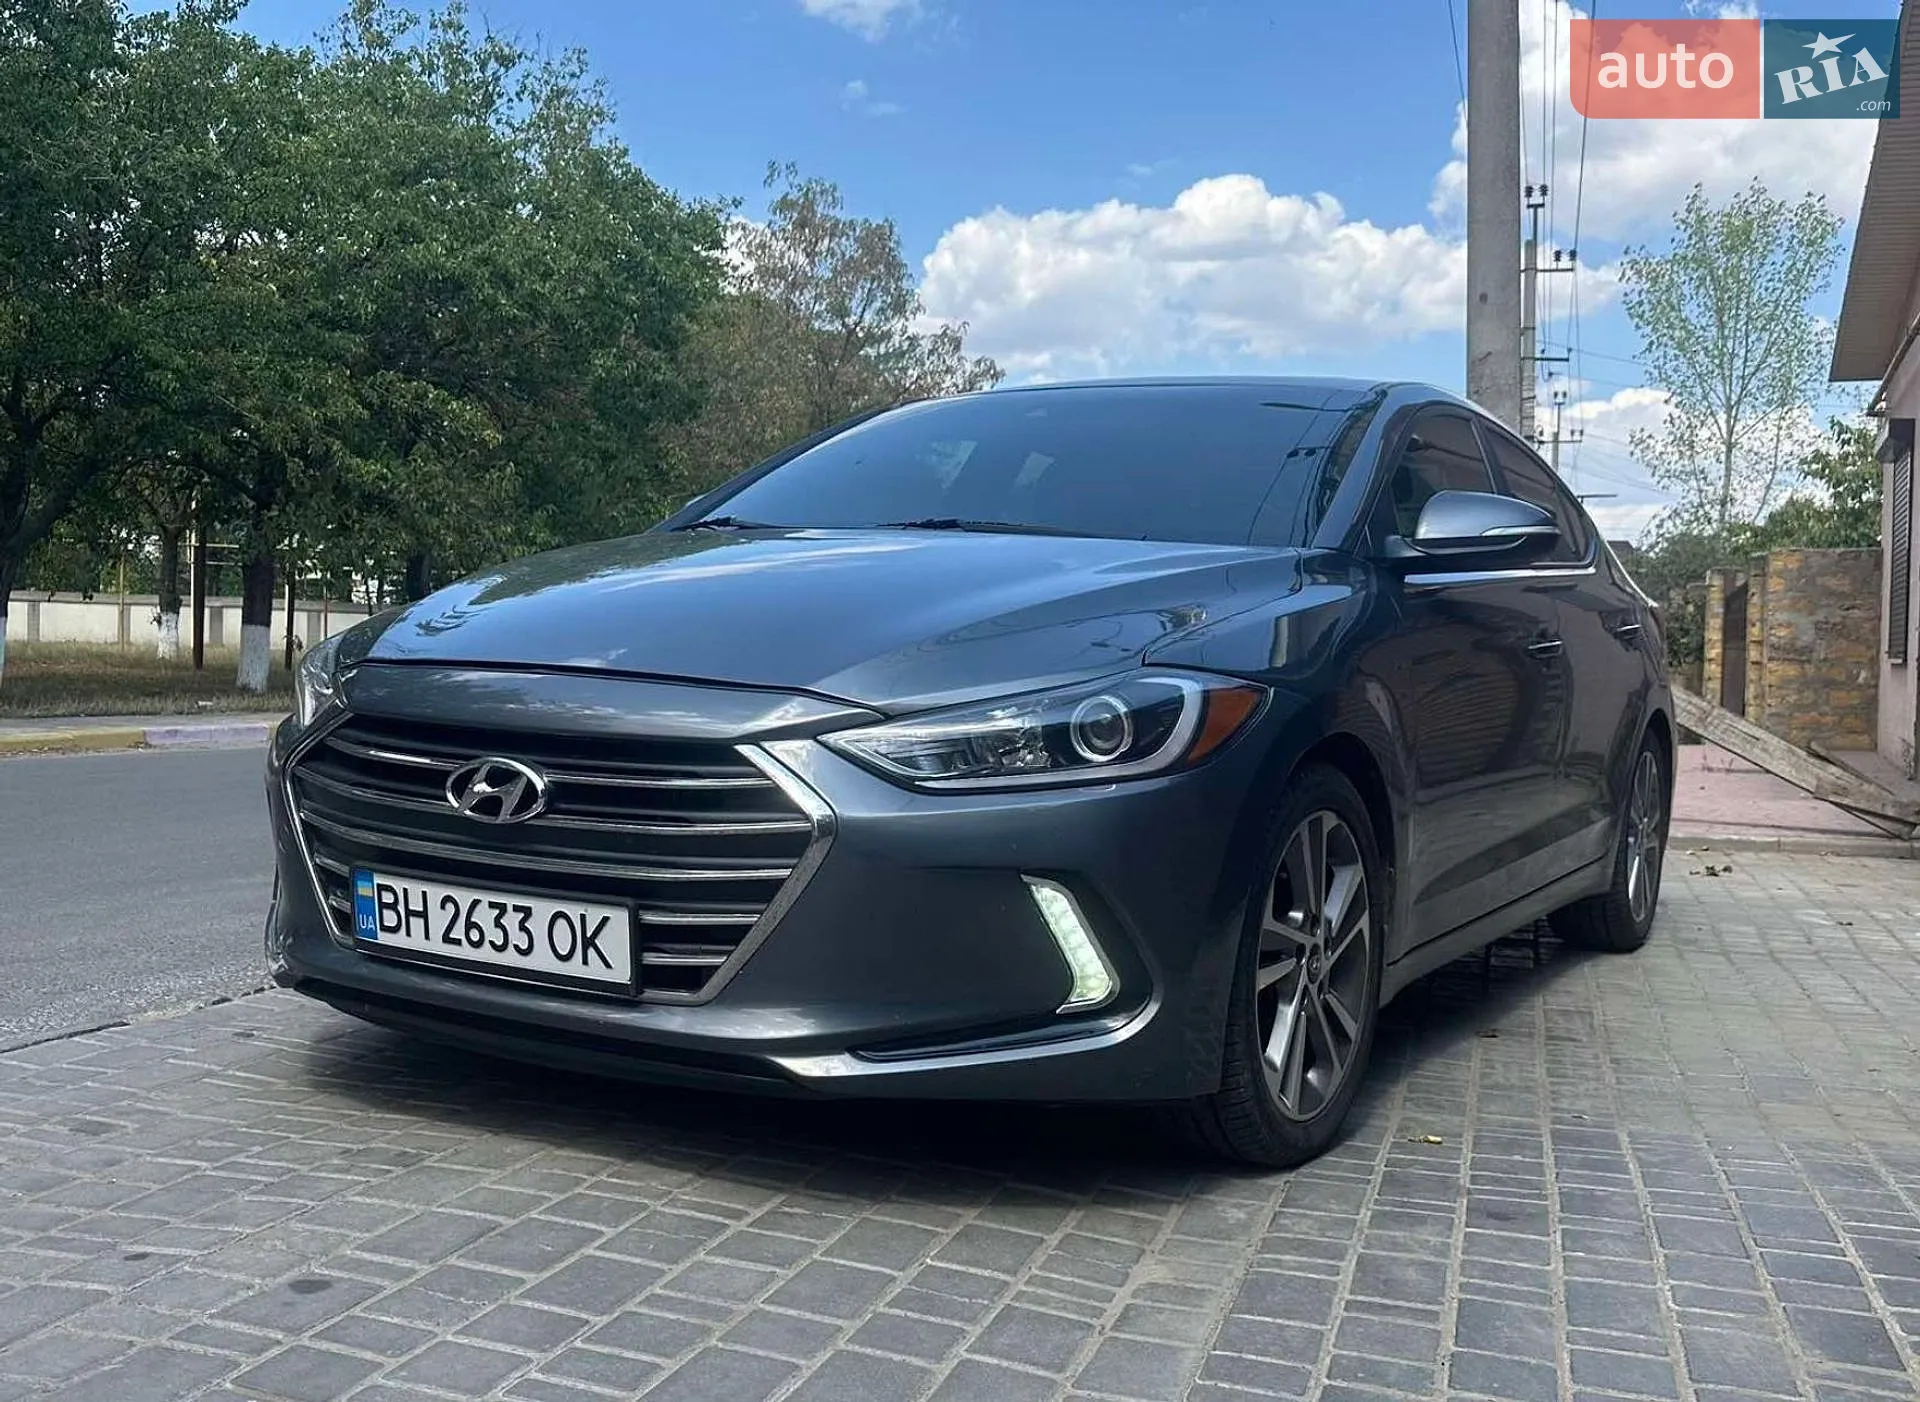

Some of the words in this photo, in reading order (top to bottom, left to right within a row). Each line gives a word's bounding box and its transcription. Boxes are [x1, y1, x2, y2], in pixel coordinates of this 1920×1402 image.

[359, 914, 376, 930] UA
[376, 883, 430, 941] BH
[440, 894, 534, 956] 2633
[548, 910, 614, 969] OK
